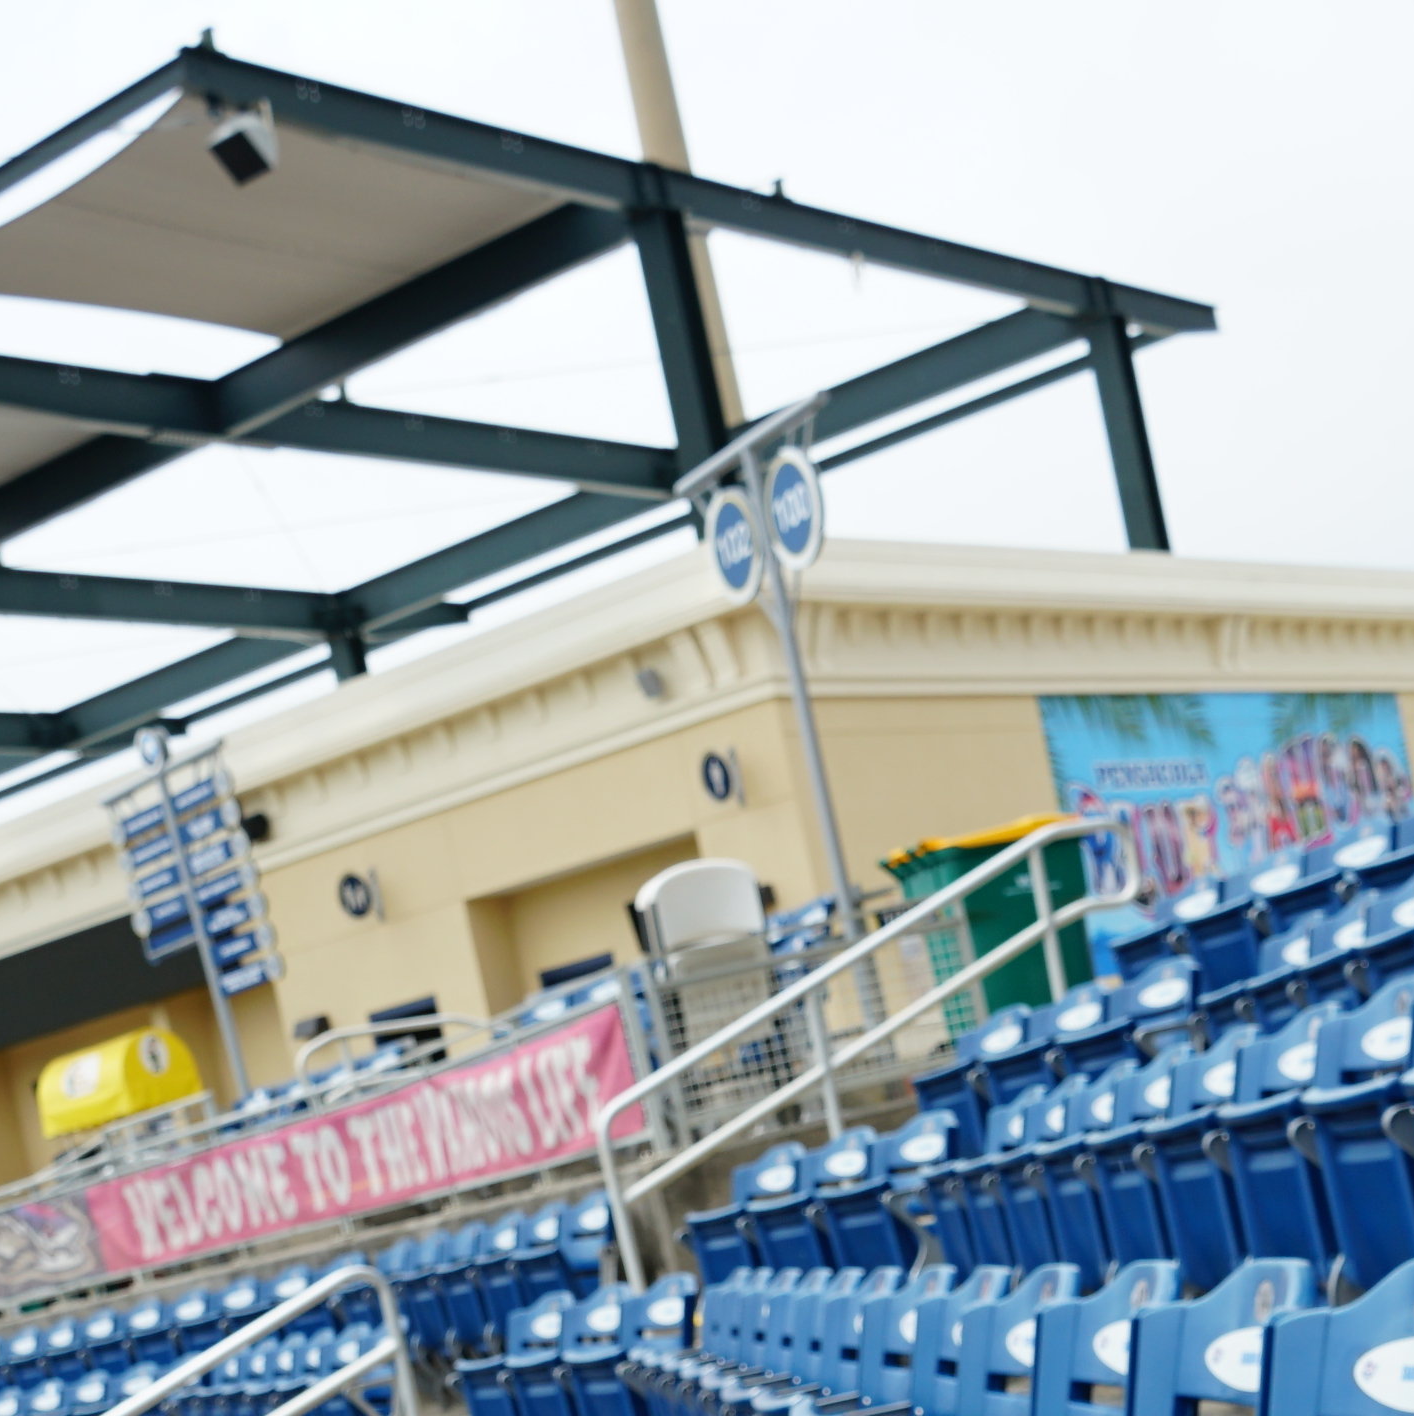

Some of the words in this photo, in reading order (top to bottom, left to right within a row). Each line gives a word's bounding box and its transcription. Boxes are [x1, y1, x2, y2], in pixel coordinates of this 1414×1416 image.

[123, 1140, 296, 1259] WELCOME
[292, 1122, 354, 1207] TO
[349, 1099, 425, 1197] THE
